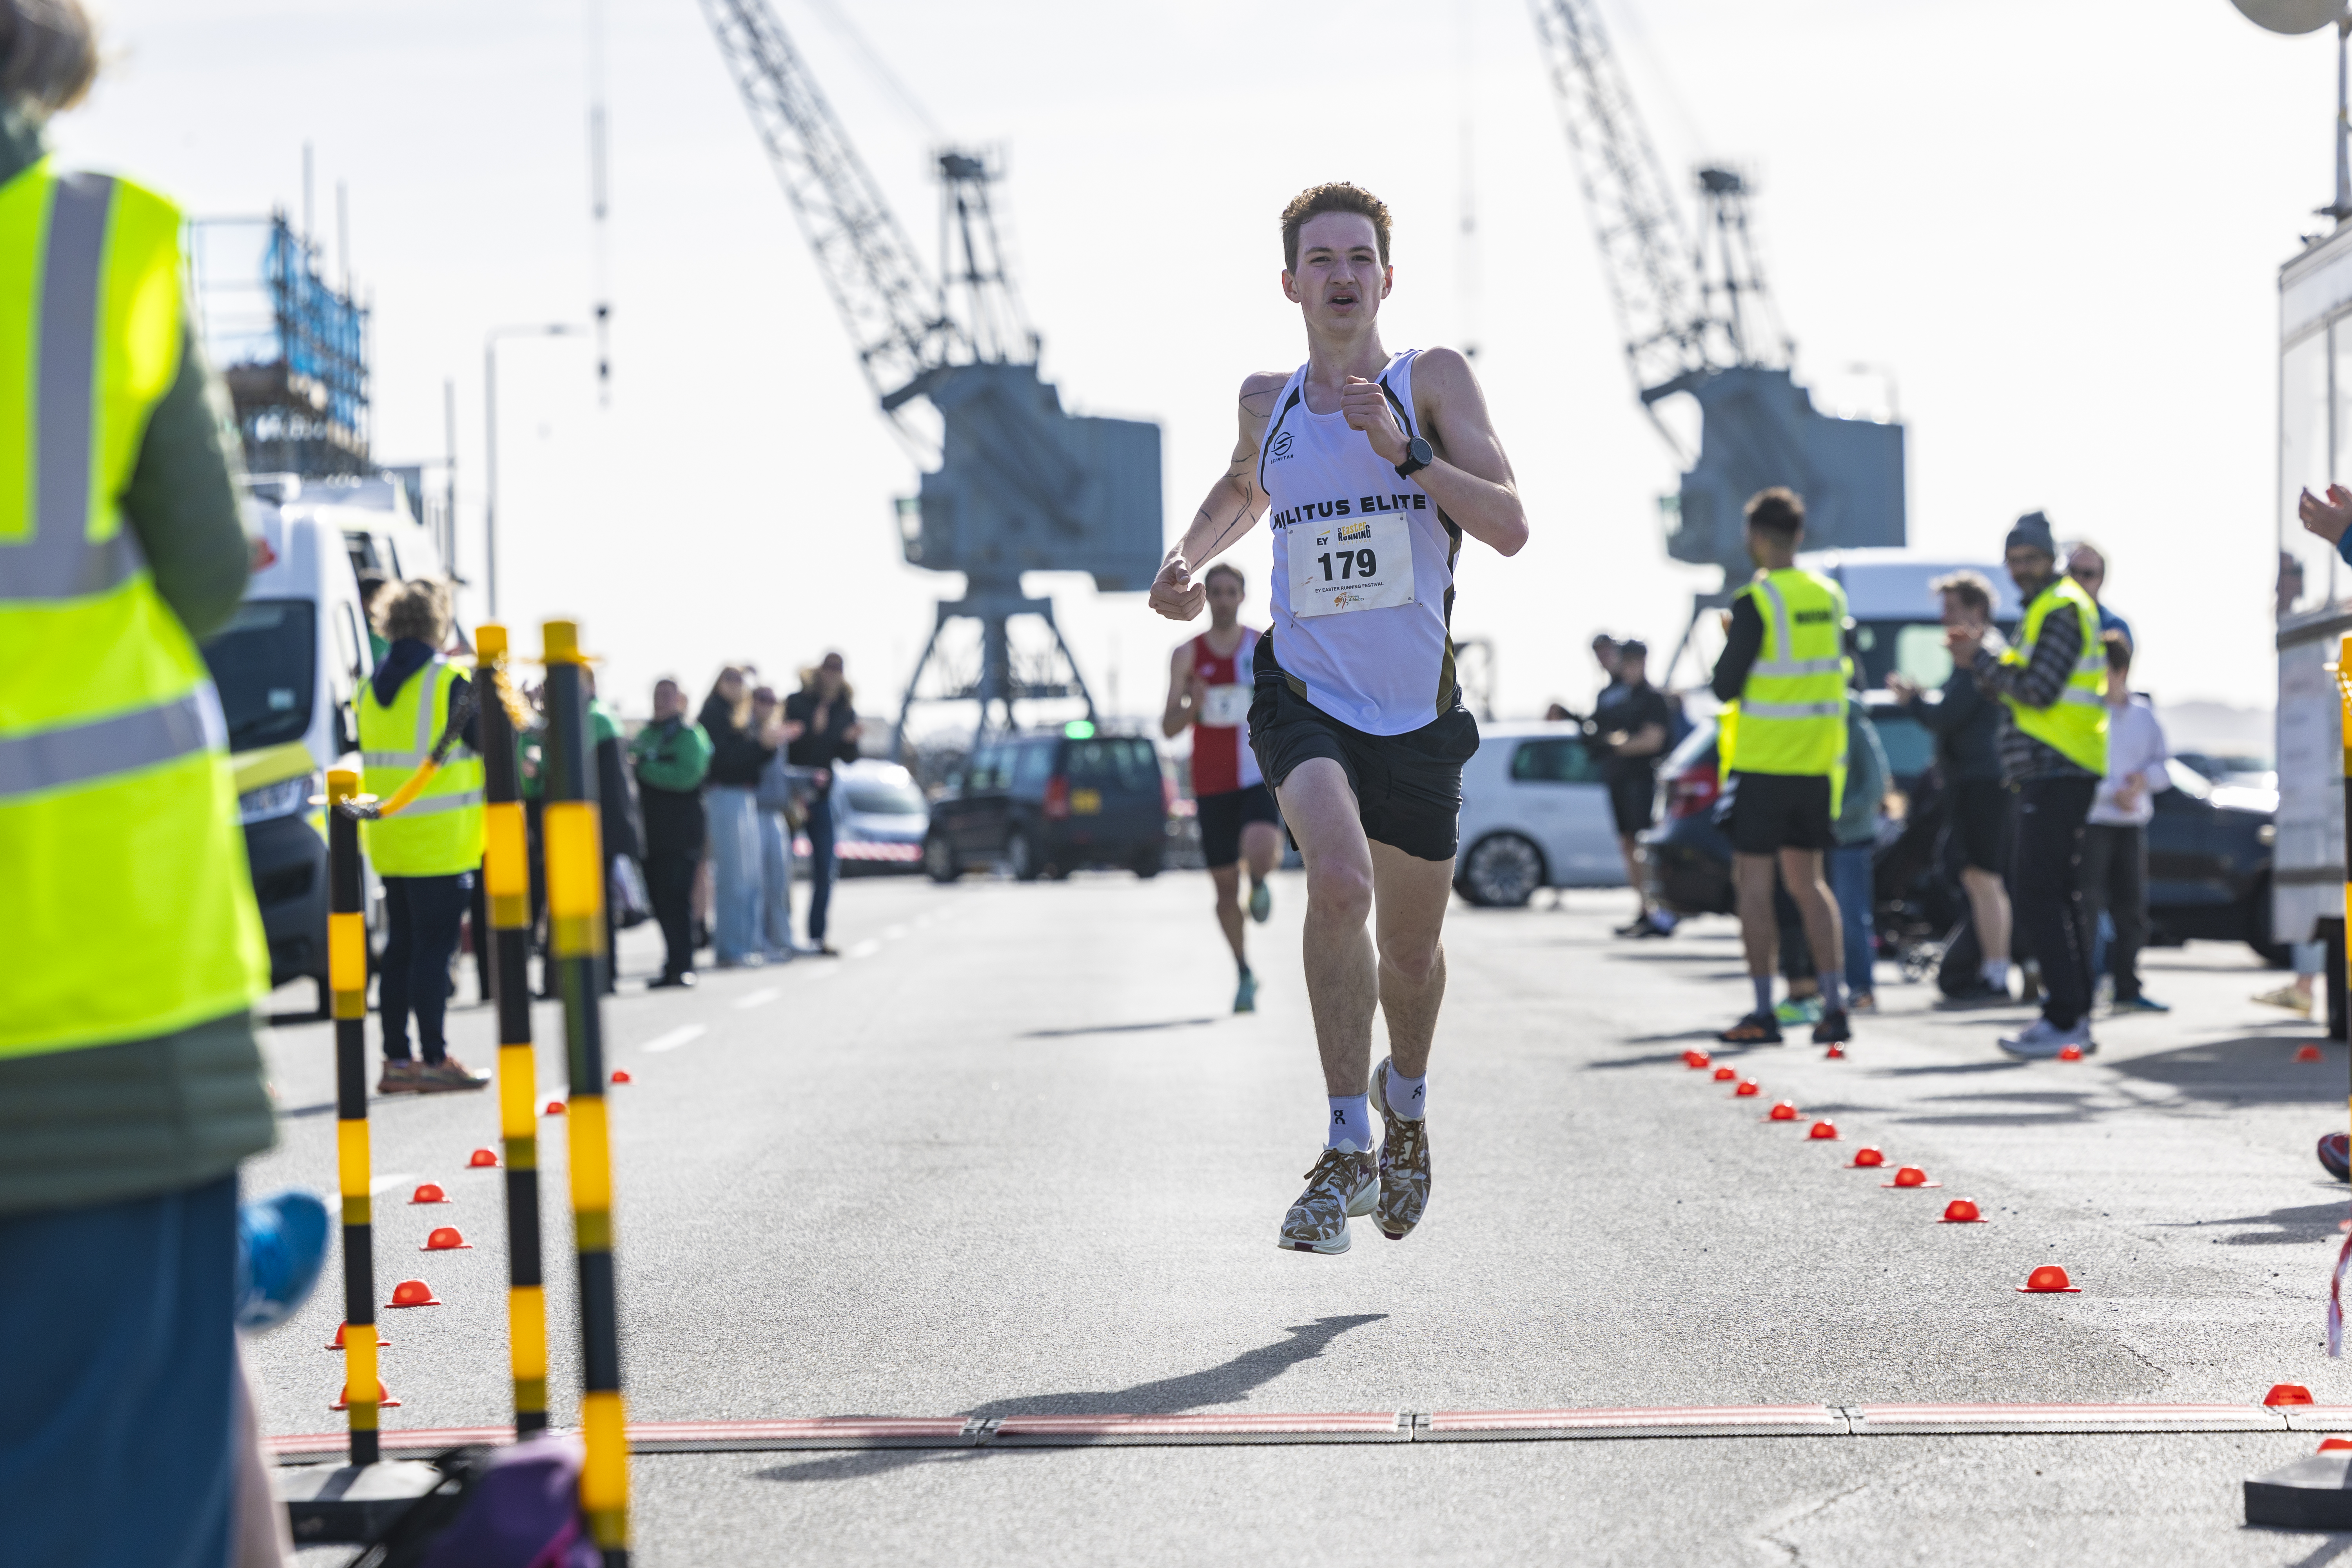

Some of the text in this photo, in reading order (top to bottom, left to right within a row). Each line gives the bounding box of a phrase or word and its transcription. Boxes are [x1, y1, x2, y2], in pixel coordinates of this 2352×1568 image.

[1271, 454, 1294, 465] SCIMITAR
[1272, 494, 1426, 530] MILITUS ELITE
[1338, 524, 1371, 542] RUNNING
[1342, 521, 1367, 536] Easter
[1316, 537, 1328, 546] EY
[1318, 548, 1377, 581] 179
